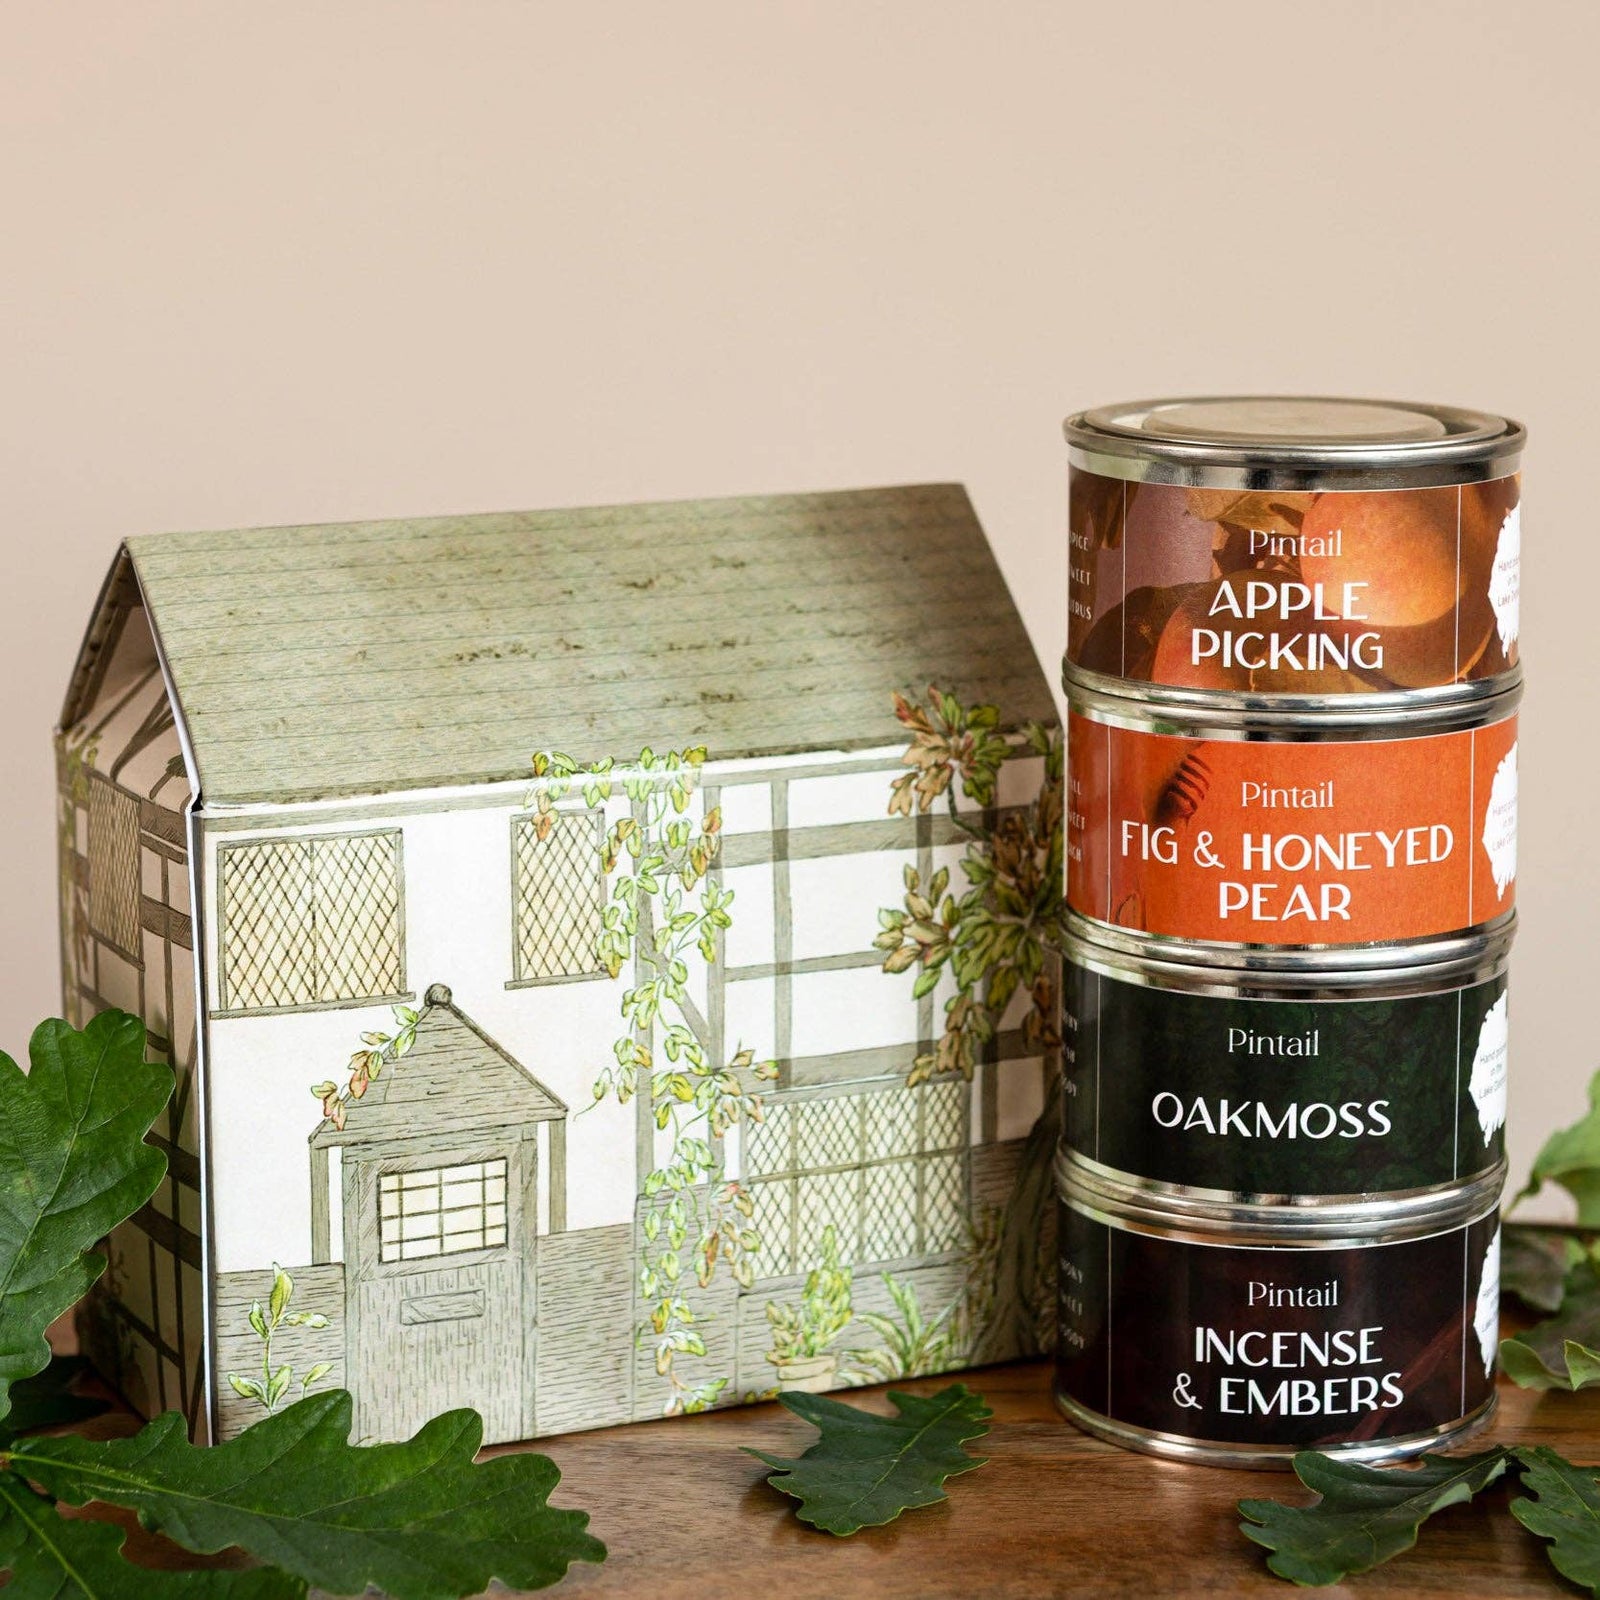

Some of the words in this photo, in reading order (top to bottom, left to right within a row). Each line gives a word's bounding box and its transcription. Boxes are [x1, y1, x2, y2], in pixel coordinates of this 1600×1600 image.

[1249, 528, 1343, 558] Pintail
[1208, 579, 1370, 621] APPLE
[1191, 627, 1384, 672] PICKING
[1240, 780, 1335, 809] Pintail
[1121, 819, 1179, 866] FIG
[1192, 829, 1226, 870] &
[1241, 823, 1455, 872] HONEYED
[1218, 880, 1353, 922] PEAR
[1227, 1026, 1321, 1058] Pintail
[1151, 1090, 1393, 1141] OAKMOSS
[1247, 1279, 1339, 1308] Pintail
[1194, 1325, 1385, 1369] INCENSE
[1171, 1371, 1204, 1411] &
[1219, 1371, 1405, 1417] EMBERS
